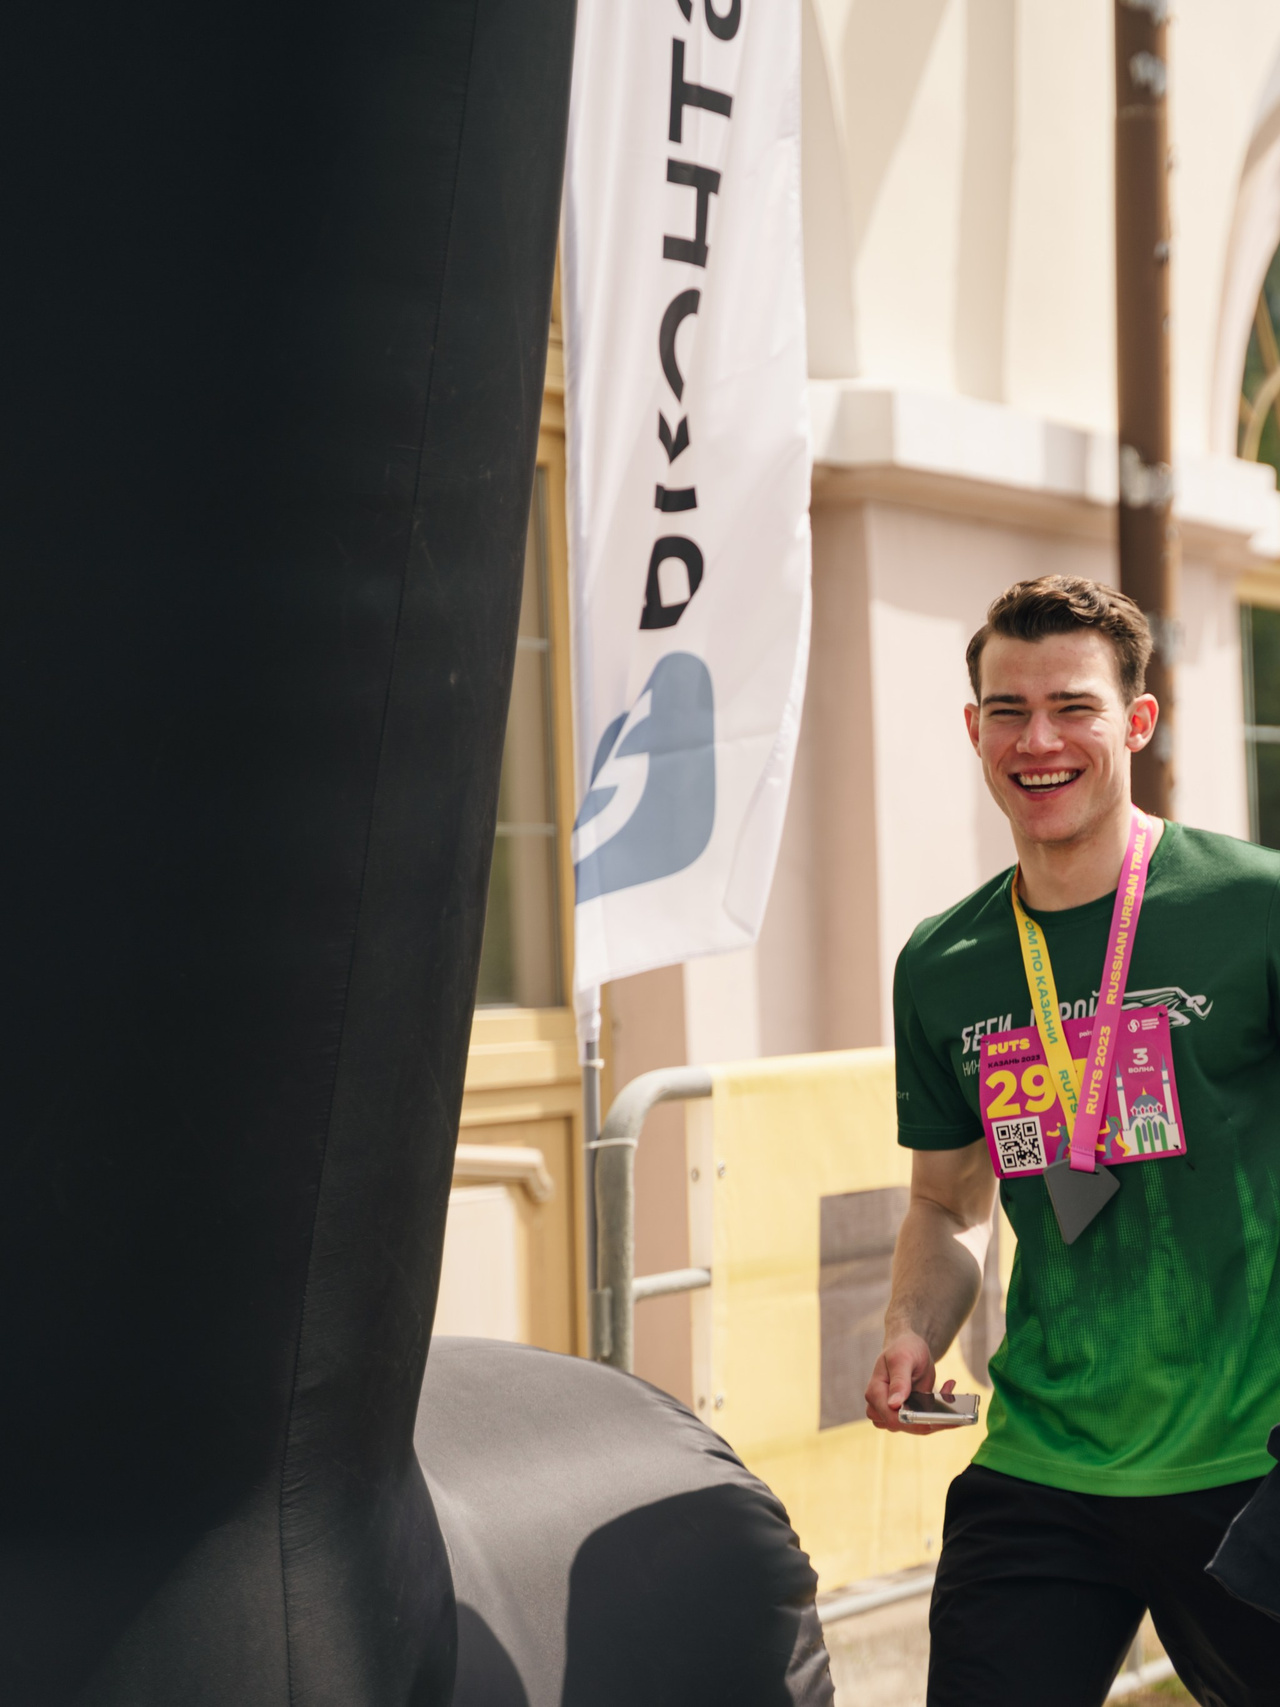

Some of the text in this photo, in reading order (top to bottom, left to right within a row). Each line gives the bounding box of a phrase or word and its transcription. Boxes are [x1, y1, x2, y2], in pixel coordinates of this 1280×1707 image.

[1030, 949, 1043, 972] ПО
[1085, 1069, 1104, 1115] RUTS
[1095, 1025, 1111, 1067] 2023
[1106, 931, 1128, 1005] RUSSIAN
[1119, 873, 1139, 928] URBAN
[1130, 831, 1147, 871] TRAIL
[1035, 975, 1058, 1044] КАЗАНИ
[987, 1038, 1031, 1057] RUTS
[1132, 1047, 1149, 1066] 3
[988, 1054, 1041, 1069] КАЗАНЬ 2023
[1128, 1065, 1155, 1074] ВОЛНА
